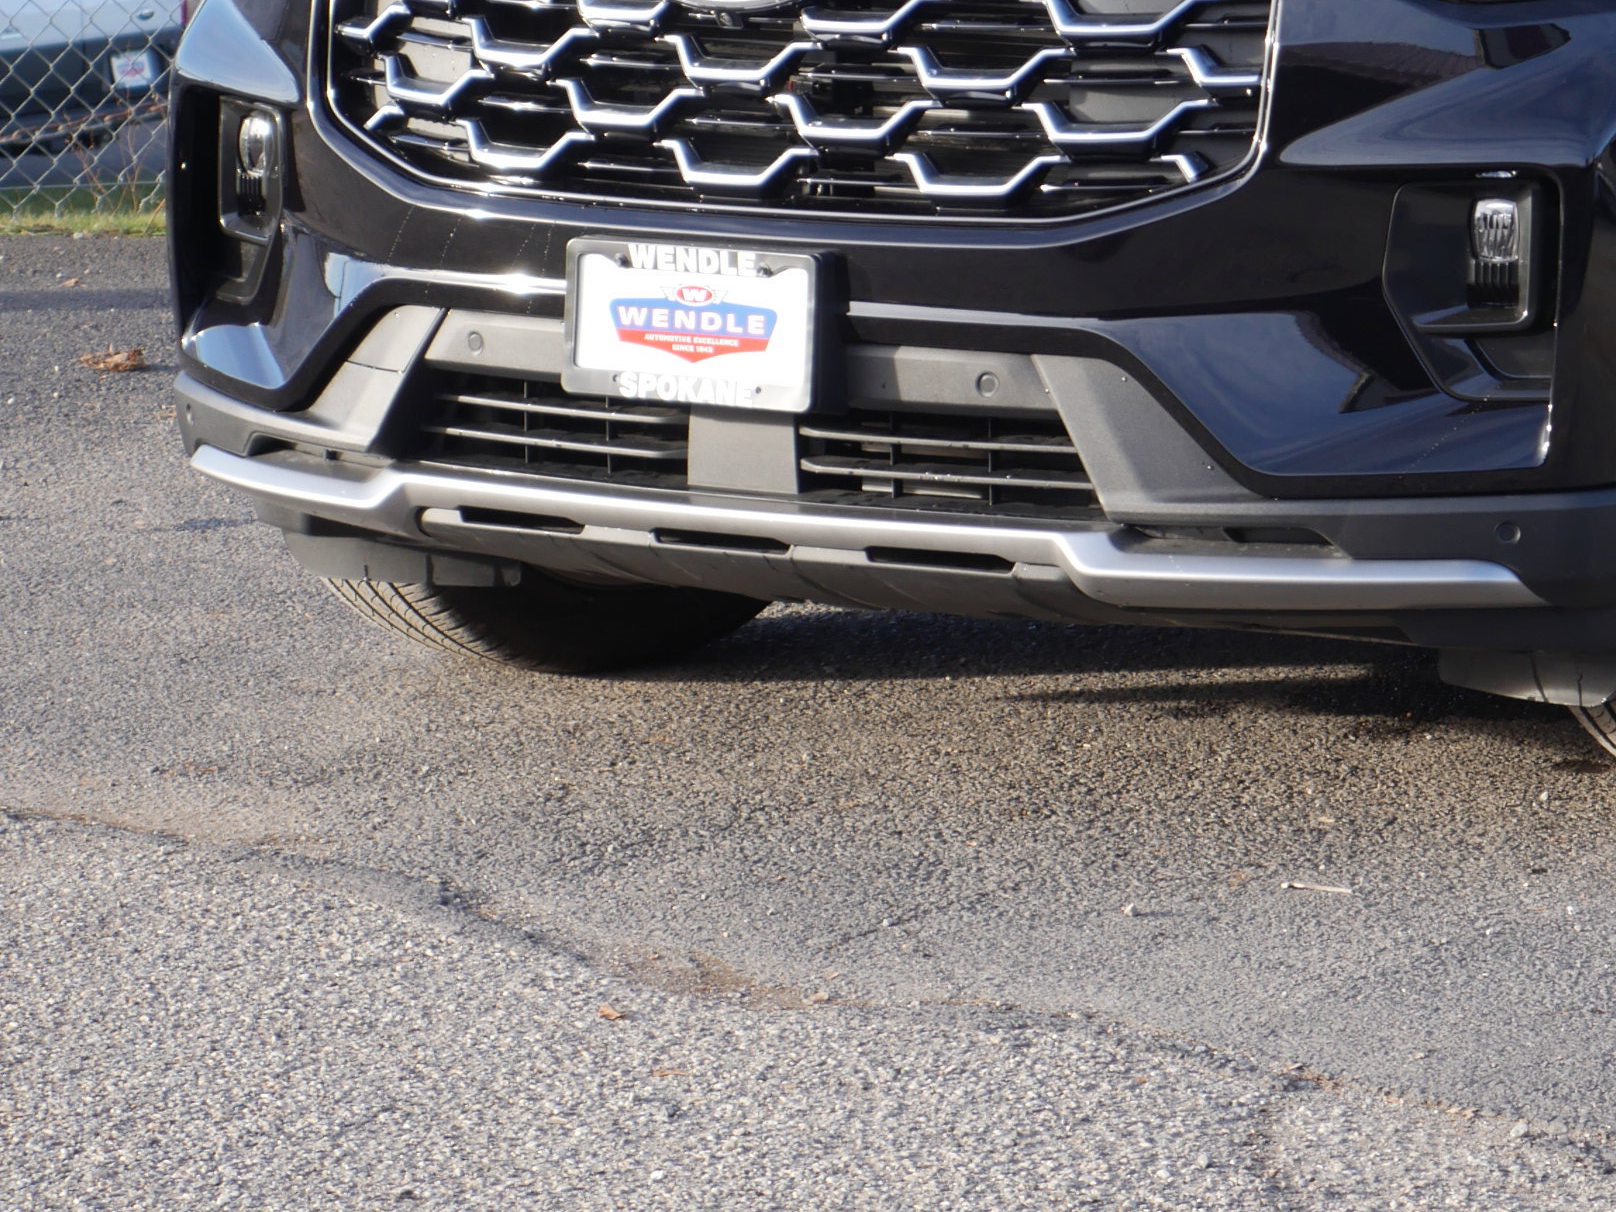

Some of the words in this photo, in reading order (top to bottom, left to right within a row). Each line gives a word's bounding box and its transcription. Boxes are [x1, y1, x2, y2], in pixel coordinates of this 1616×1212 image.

[627, 243, 757, 277] WENDLE
[617, 306, 765, 335] WENDLE
[618, 370, 752, 408] SPOKANE
